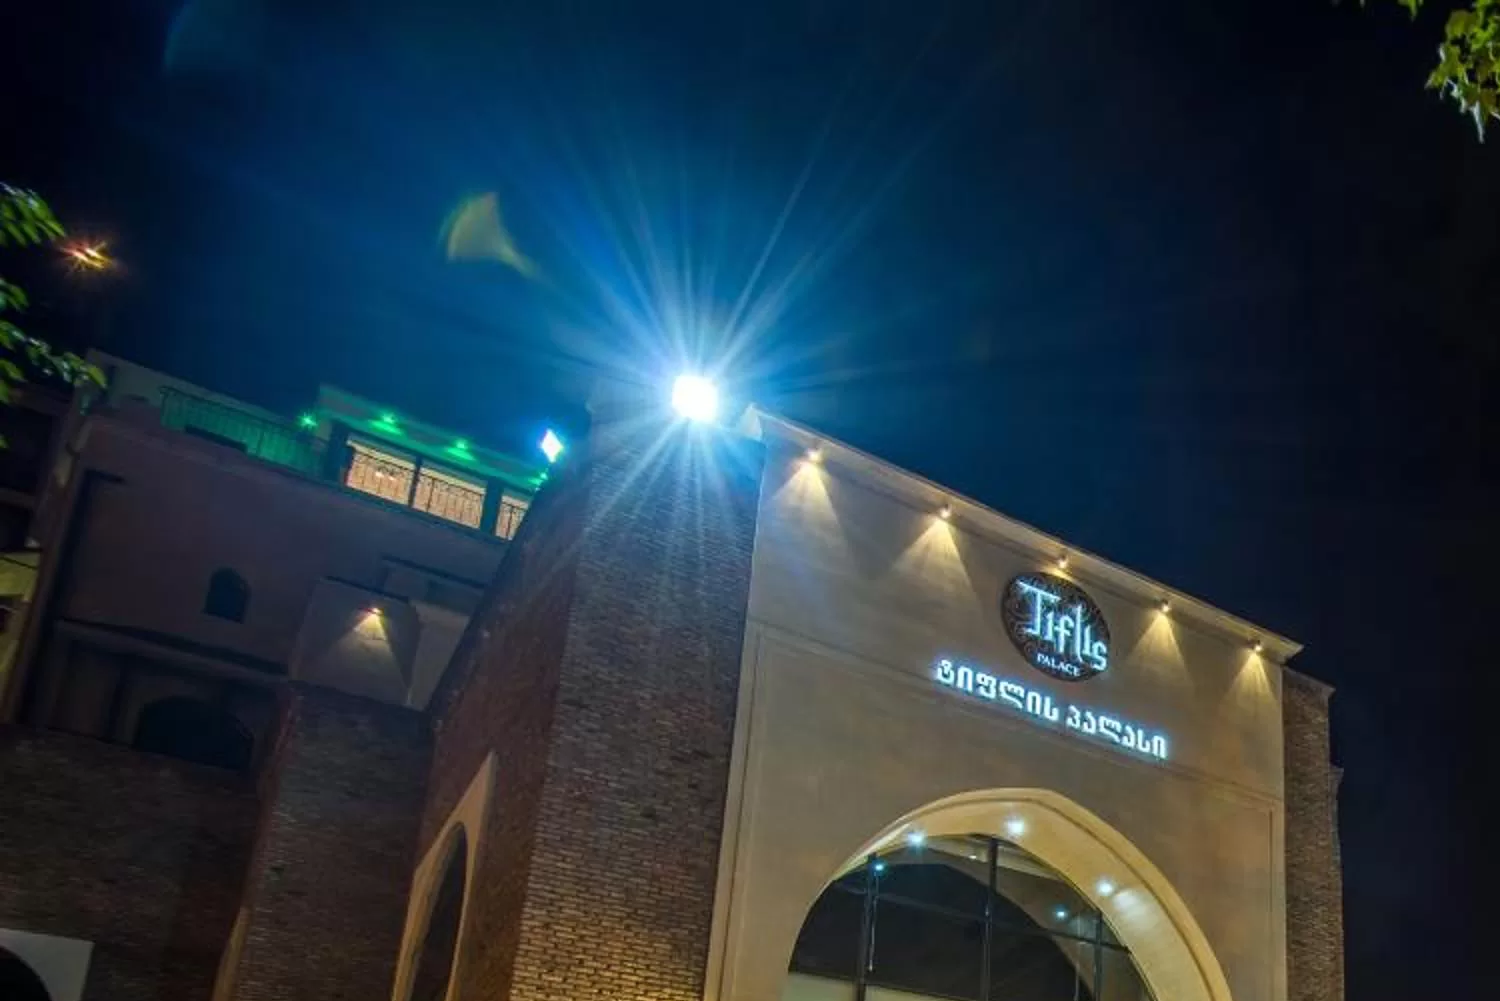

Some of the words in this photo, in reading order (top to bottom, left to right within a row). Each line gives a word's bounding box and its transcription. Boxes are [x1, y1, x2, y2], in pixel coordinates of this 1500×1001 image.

[1036, 652, 1081, 677] PALACE
[936, 659, 1059, 721] ტიფლის
[1067, 706, 1166, 758] პალასი
